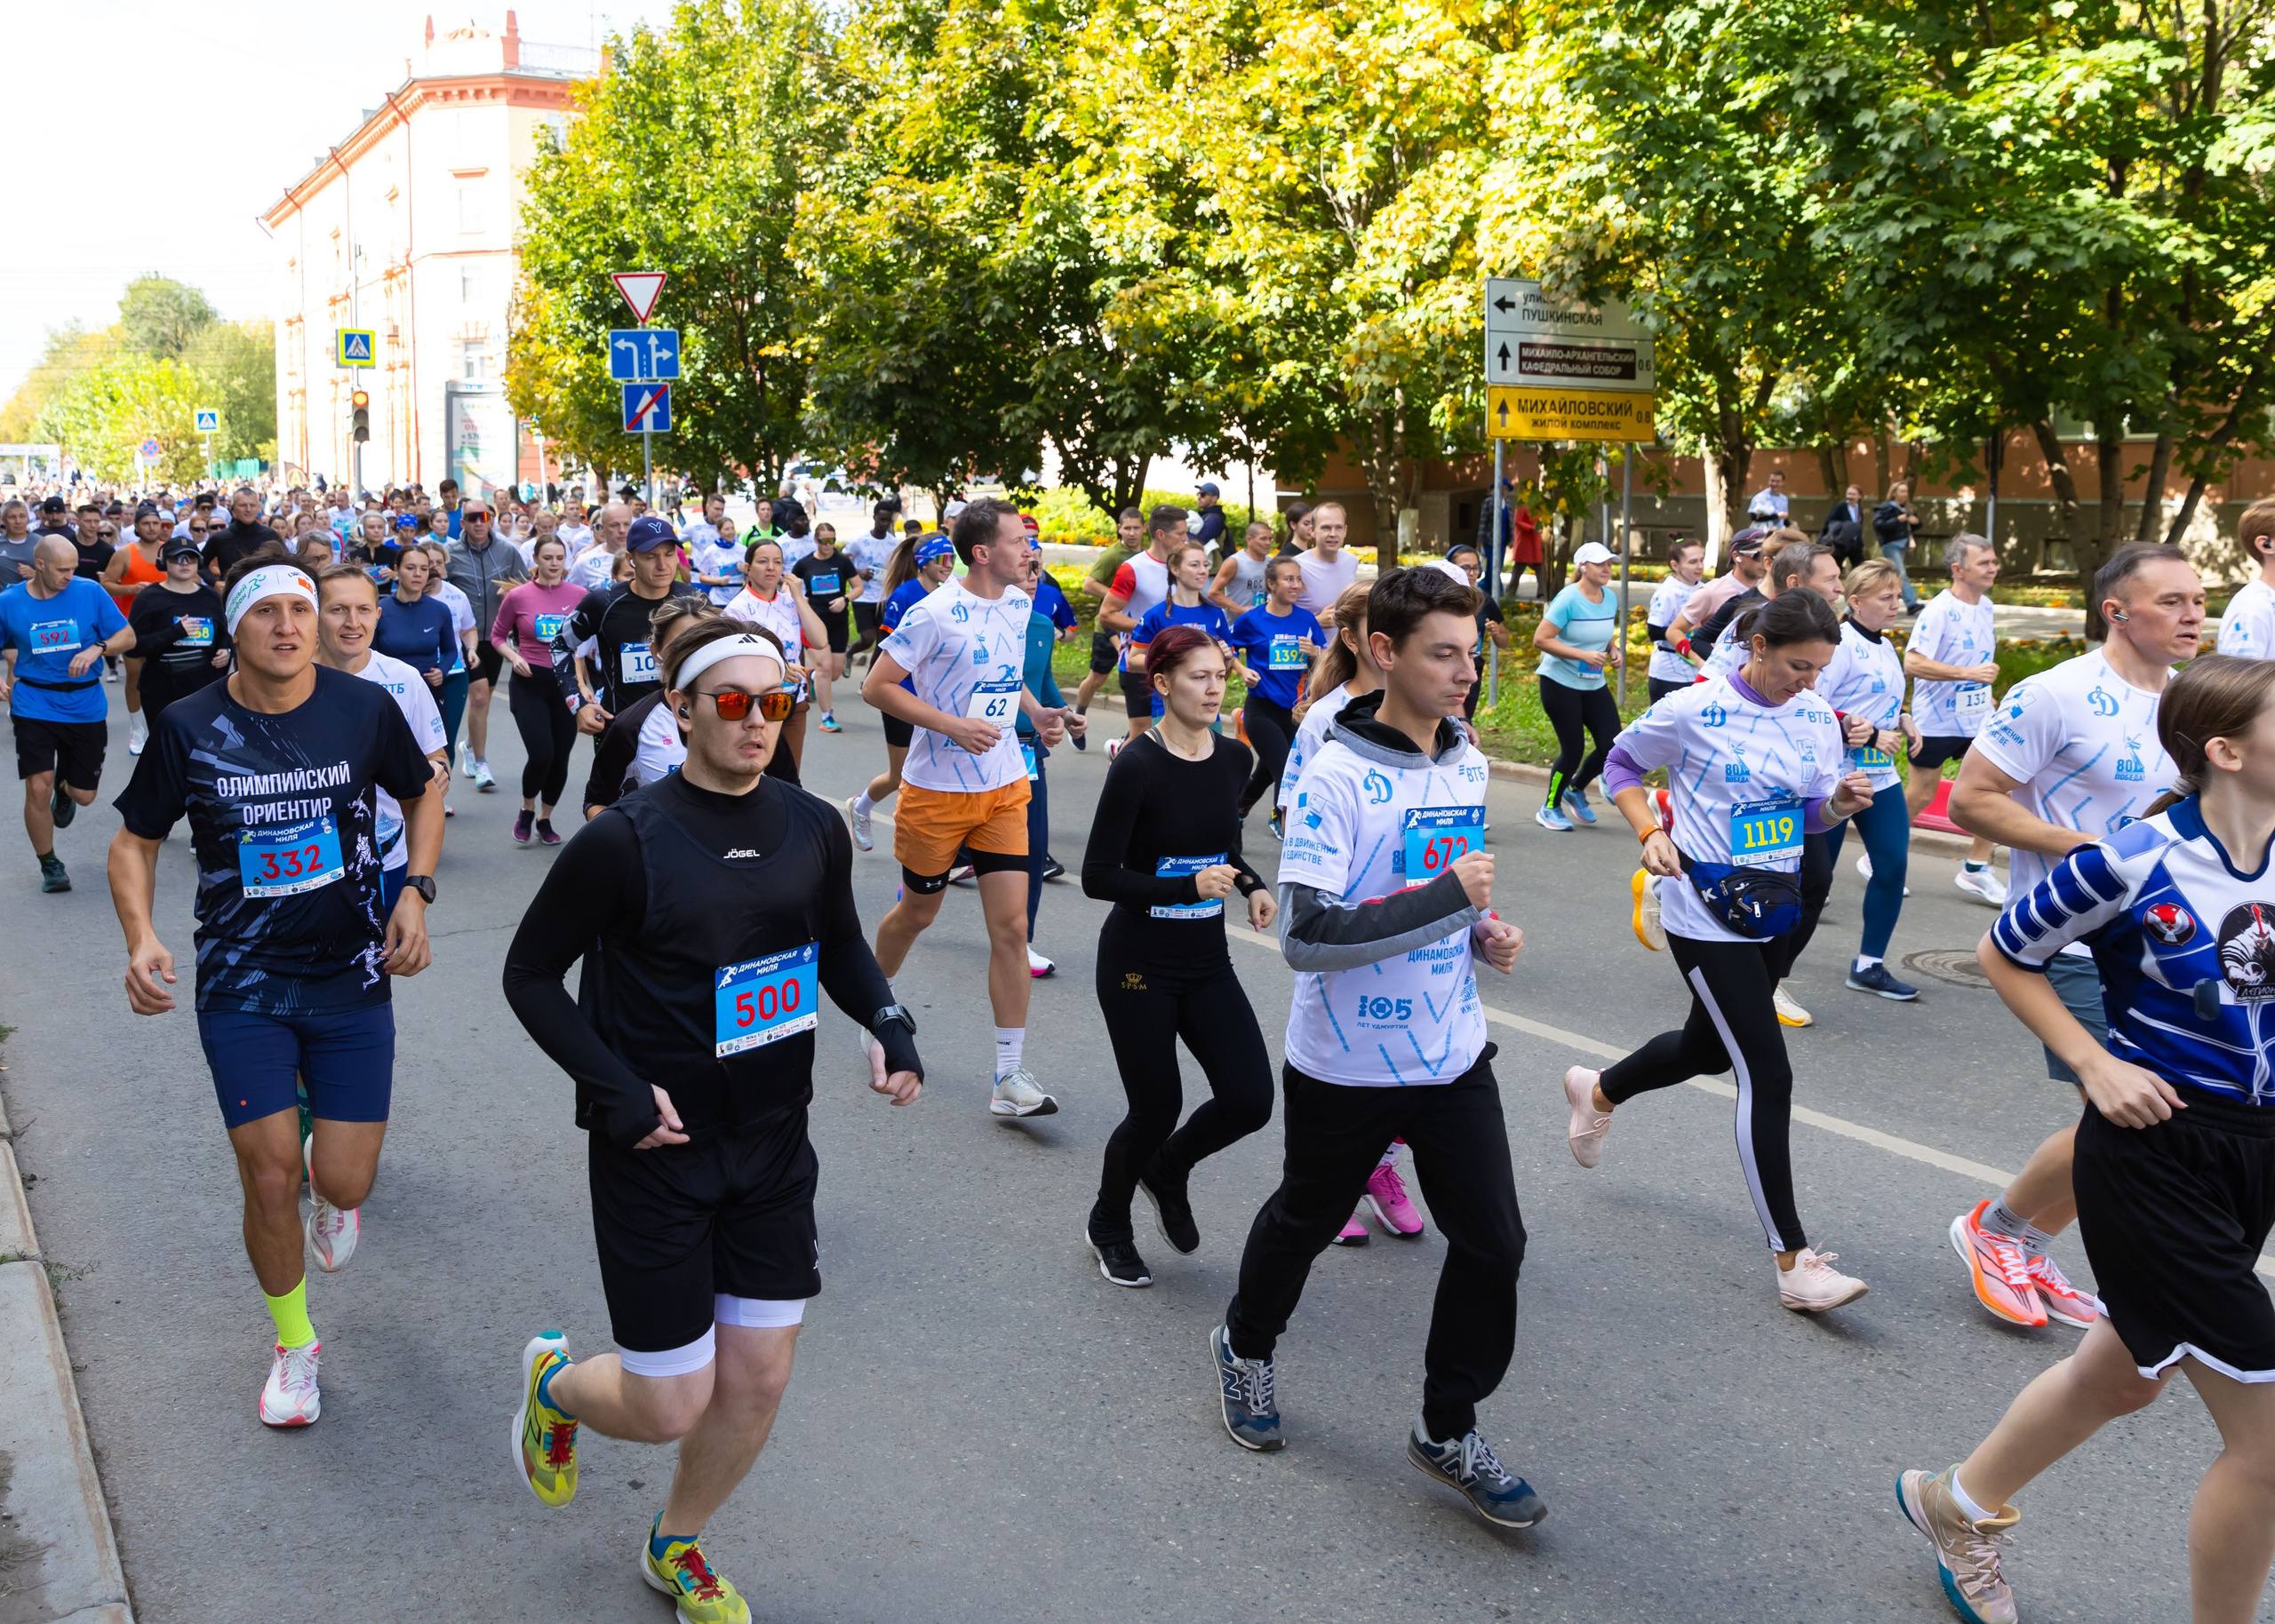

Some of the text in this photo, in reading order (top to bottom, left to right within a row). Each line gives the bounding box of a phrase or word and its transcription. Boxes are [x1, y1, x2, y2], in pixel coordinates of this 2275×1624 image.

[1521, 308, 1602, 325] ПУШКИНСКАЯ
[1521, 361, 1623, 376] КАФЕДРАЛЬНЫЙ СОБОР
[1517, 397, 1632, 417] МИХАЙЛОВСКИЙ
[1531, 417, 1621, 430] жилой комплекс
[39, 630, 70, 645] 592
[985, 697, 1008, 717] 62
[1966, 692, 1987, 707] 132
[1808, 711, 1832, 724] ВТБ
[1725, 763, 1739, 776] 80
[2116, 759, 2133, 773] 80
[216, 760, 351, 799] ОЛИМПИЙСКИЙ
[1465, 766, 1486, 783] ВТБ
[2114, 773, 2145, 782] ПОБЕДА!
[242, 796, 332, 825] ОРИЕНТИР
[1747, 799, 1792, 809] ДИНАМОВСКАЯ
[1421, 808, 1468, 819] ДИНАМОВСКАЯ
[257, 821, 315, 837] ДИНАМОВСКАЯ
[1435, 817, 1454, 826] МИЛЯ
[275, 833, 299, 843] МИЛЯ
[1744, 816, 1794, 848] 1119
[723, 848, 761, 859] JÖGEL
[1294, 838, 1338, 856] ДВИЖЕНИИ
[1424, 835, 1469, 870] 672
[259, 844, 323, 880] 332
[1177, 856, 1218, 865] ДИНАМОВСКАЯ
[1286, 850, 1322, 865] ЕДИНСТВЕ
[1408, 945, 1465, 963] ДИНАМОВСКАЯ
[738, 950, 798, 974] ДИНАМОВСКАЯ
[756, 963, 778, 976] МИЛЯ
[1431, 960, 1453, 975] МИЛЯ
[735, 978, 801, 1028] 500
